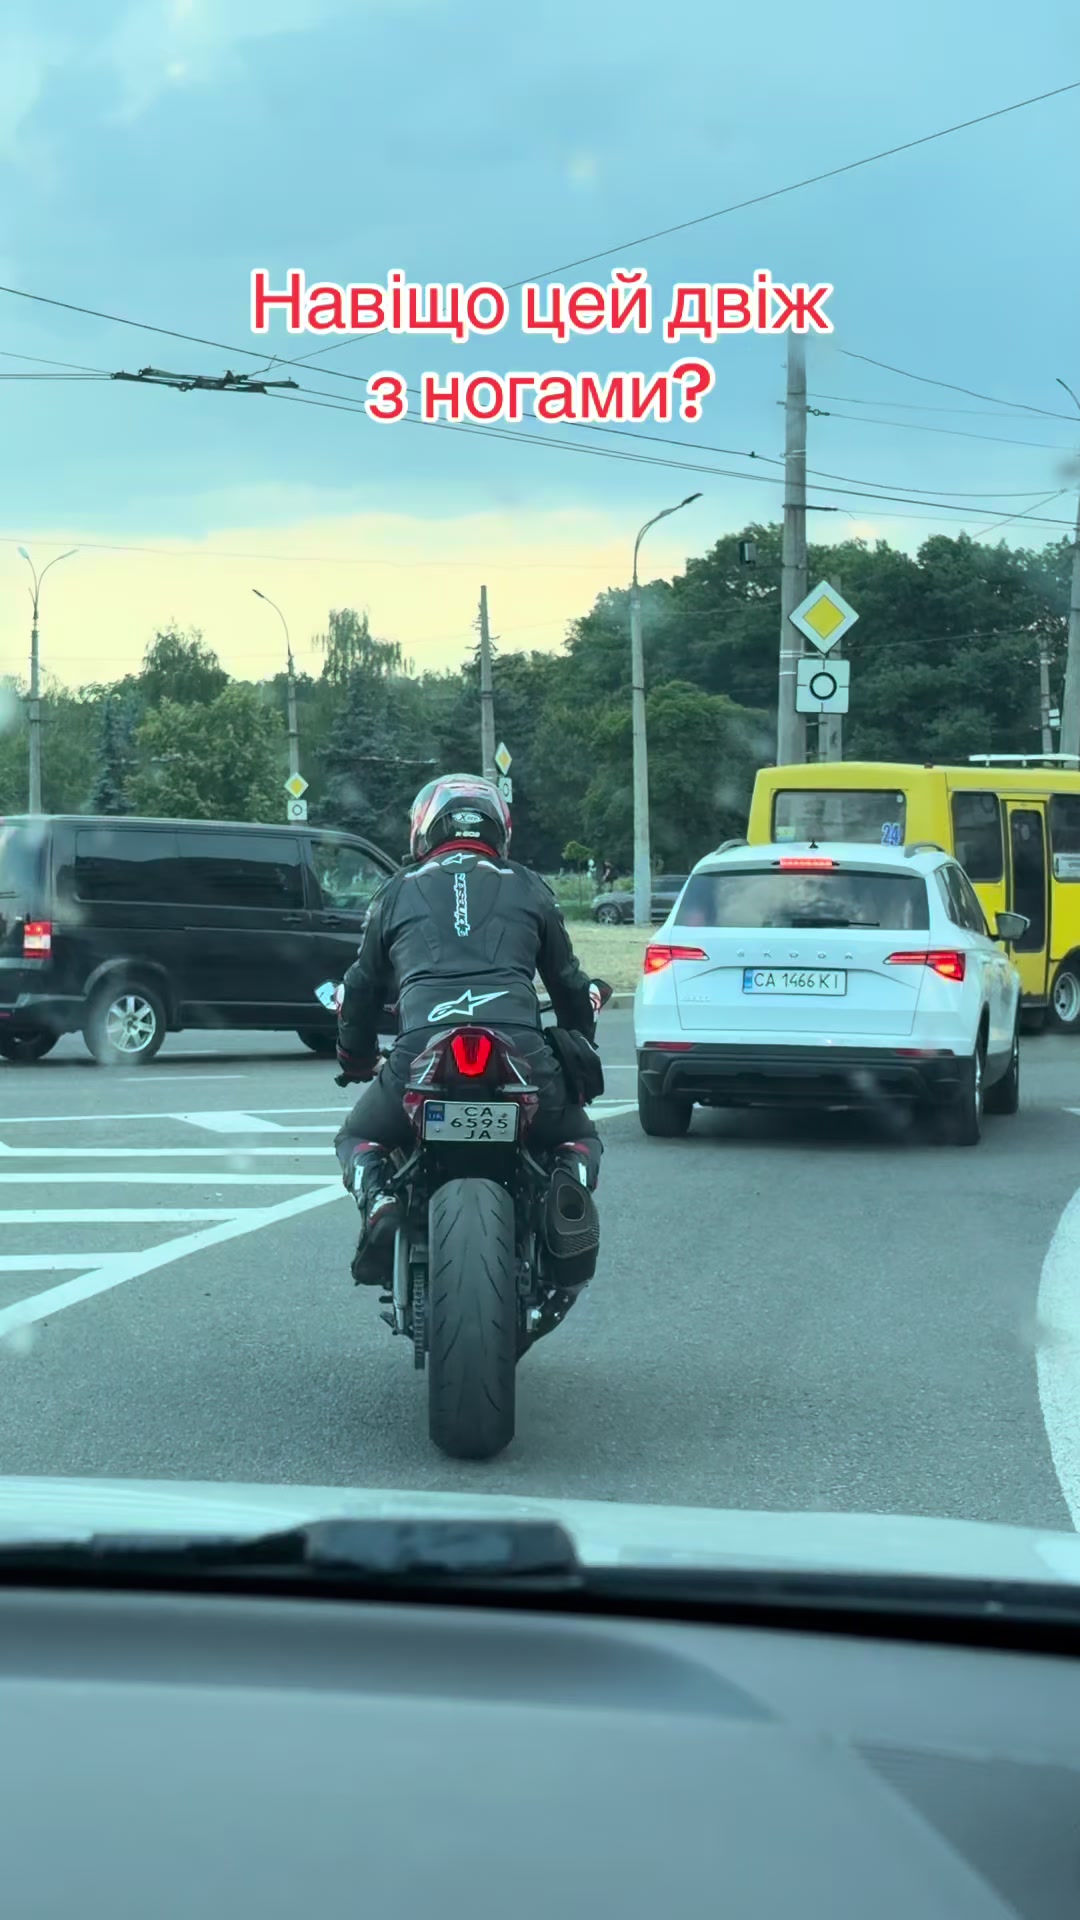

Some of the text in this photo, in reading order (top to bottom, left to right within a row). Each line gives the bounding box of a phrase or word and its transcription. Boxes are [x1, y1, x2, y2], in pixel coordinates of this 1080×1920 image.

[754, 973, 839, 989] CA 1466 KI
[464, 1106, 493, 1117] CA
[450, 1118, 508, 1129] 6595
[464, 1130, 492, 1140] JA
